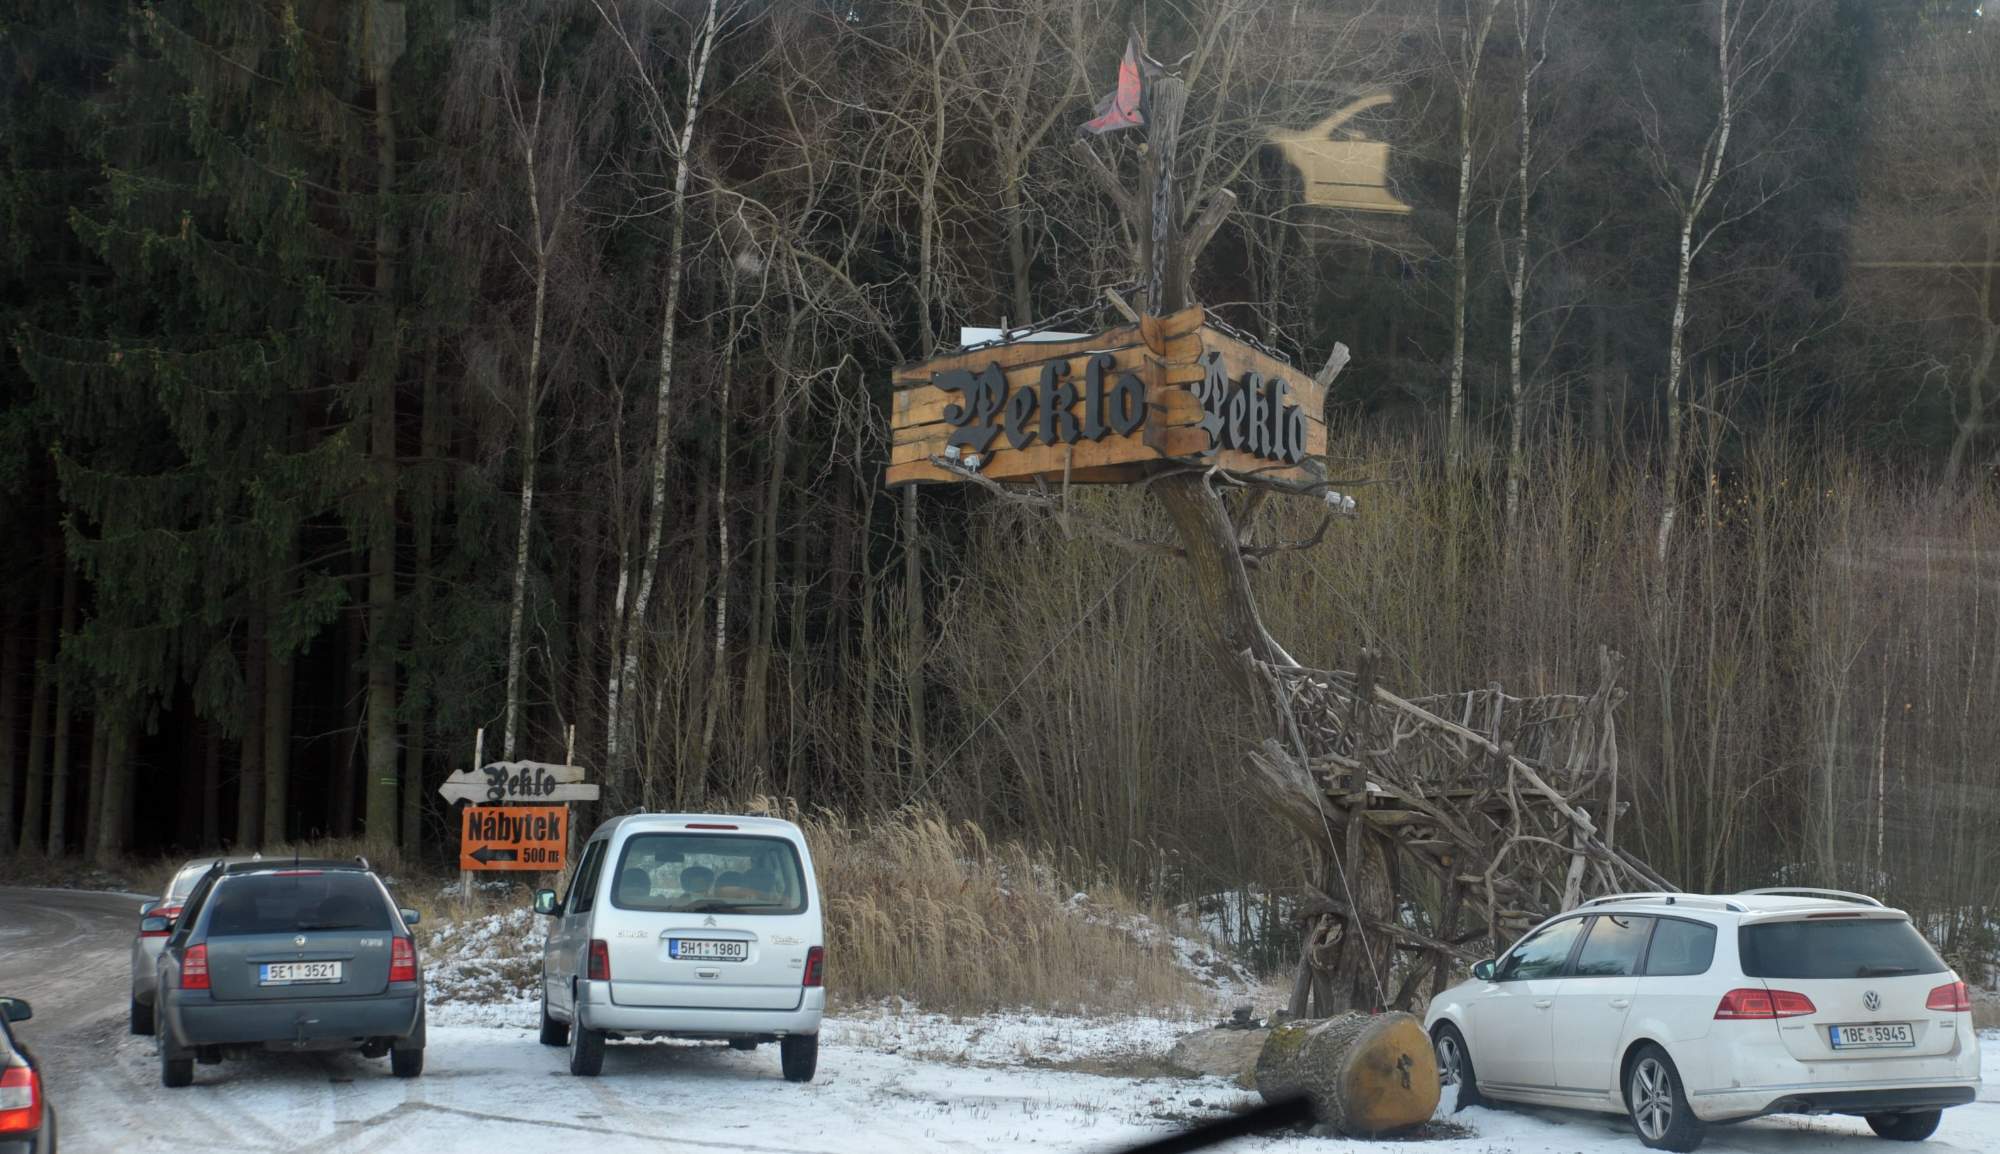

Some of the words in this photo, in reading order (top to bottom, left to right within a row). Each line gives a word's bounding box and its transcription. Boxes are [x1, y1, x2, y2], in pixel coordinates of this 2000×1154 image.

[931, 353, 1148, 472] Peklo
[1191, 351, 1306, 464] Peklo
[483, 766, 556, 800] Peklo
[468, 810, 560, 844] Nábytek
[523, 848, 546, 863] 500
[548, 850, 559, 863] m
[680, 941, 701, 955] 5H1
[712, 942, 741, 956] 1980
[270, 965, 294, 979] 5E1
[304, 963, 335, 977] 3521
[1843, 1028, 1867, 1042] 1BE
[1875, 1027, 1907, 1042] 5945
